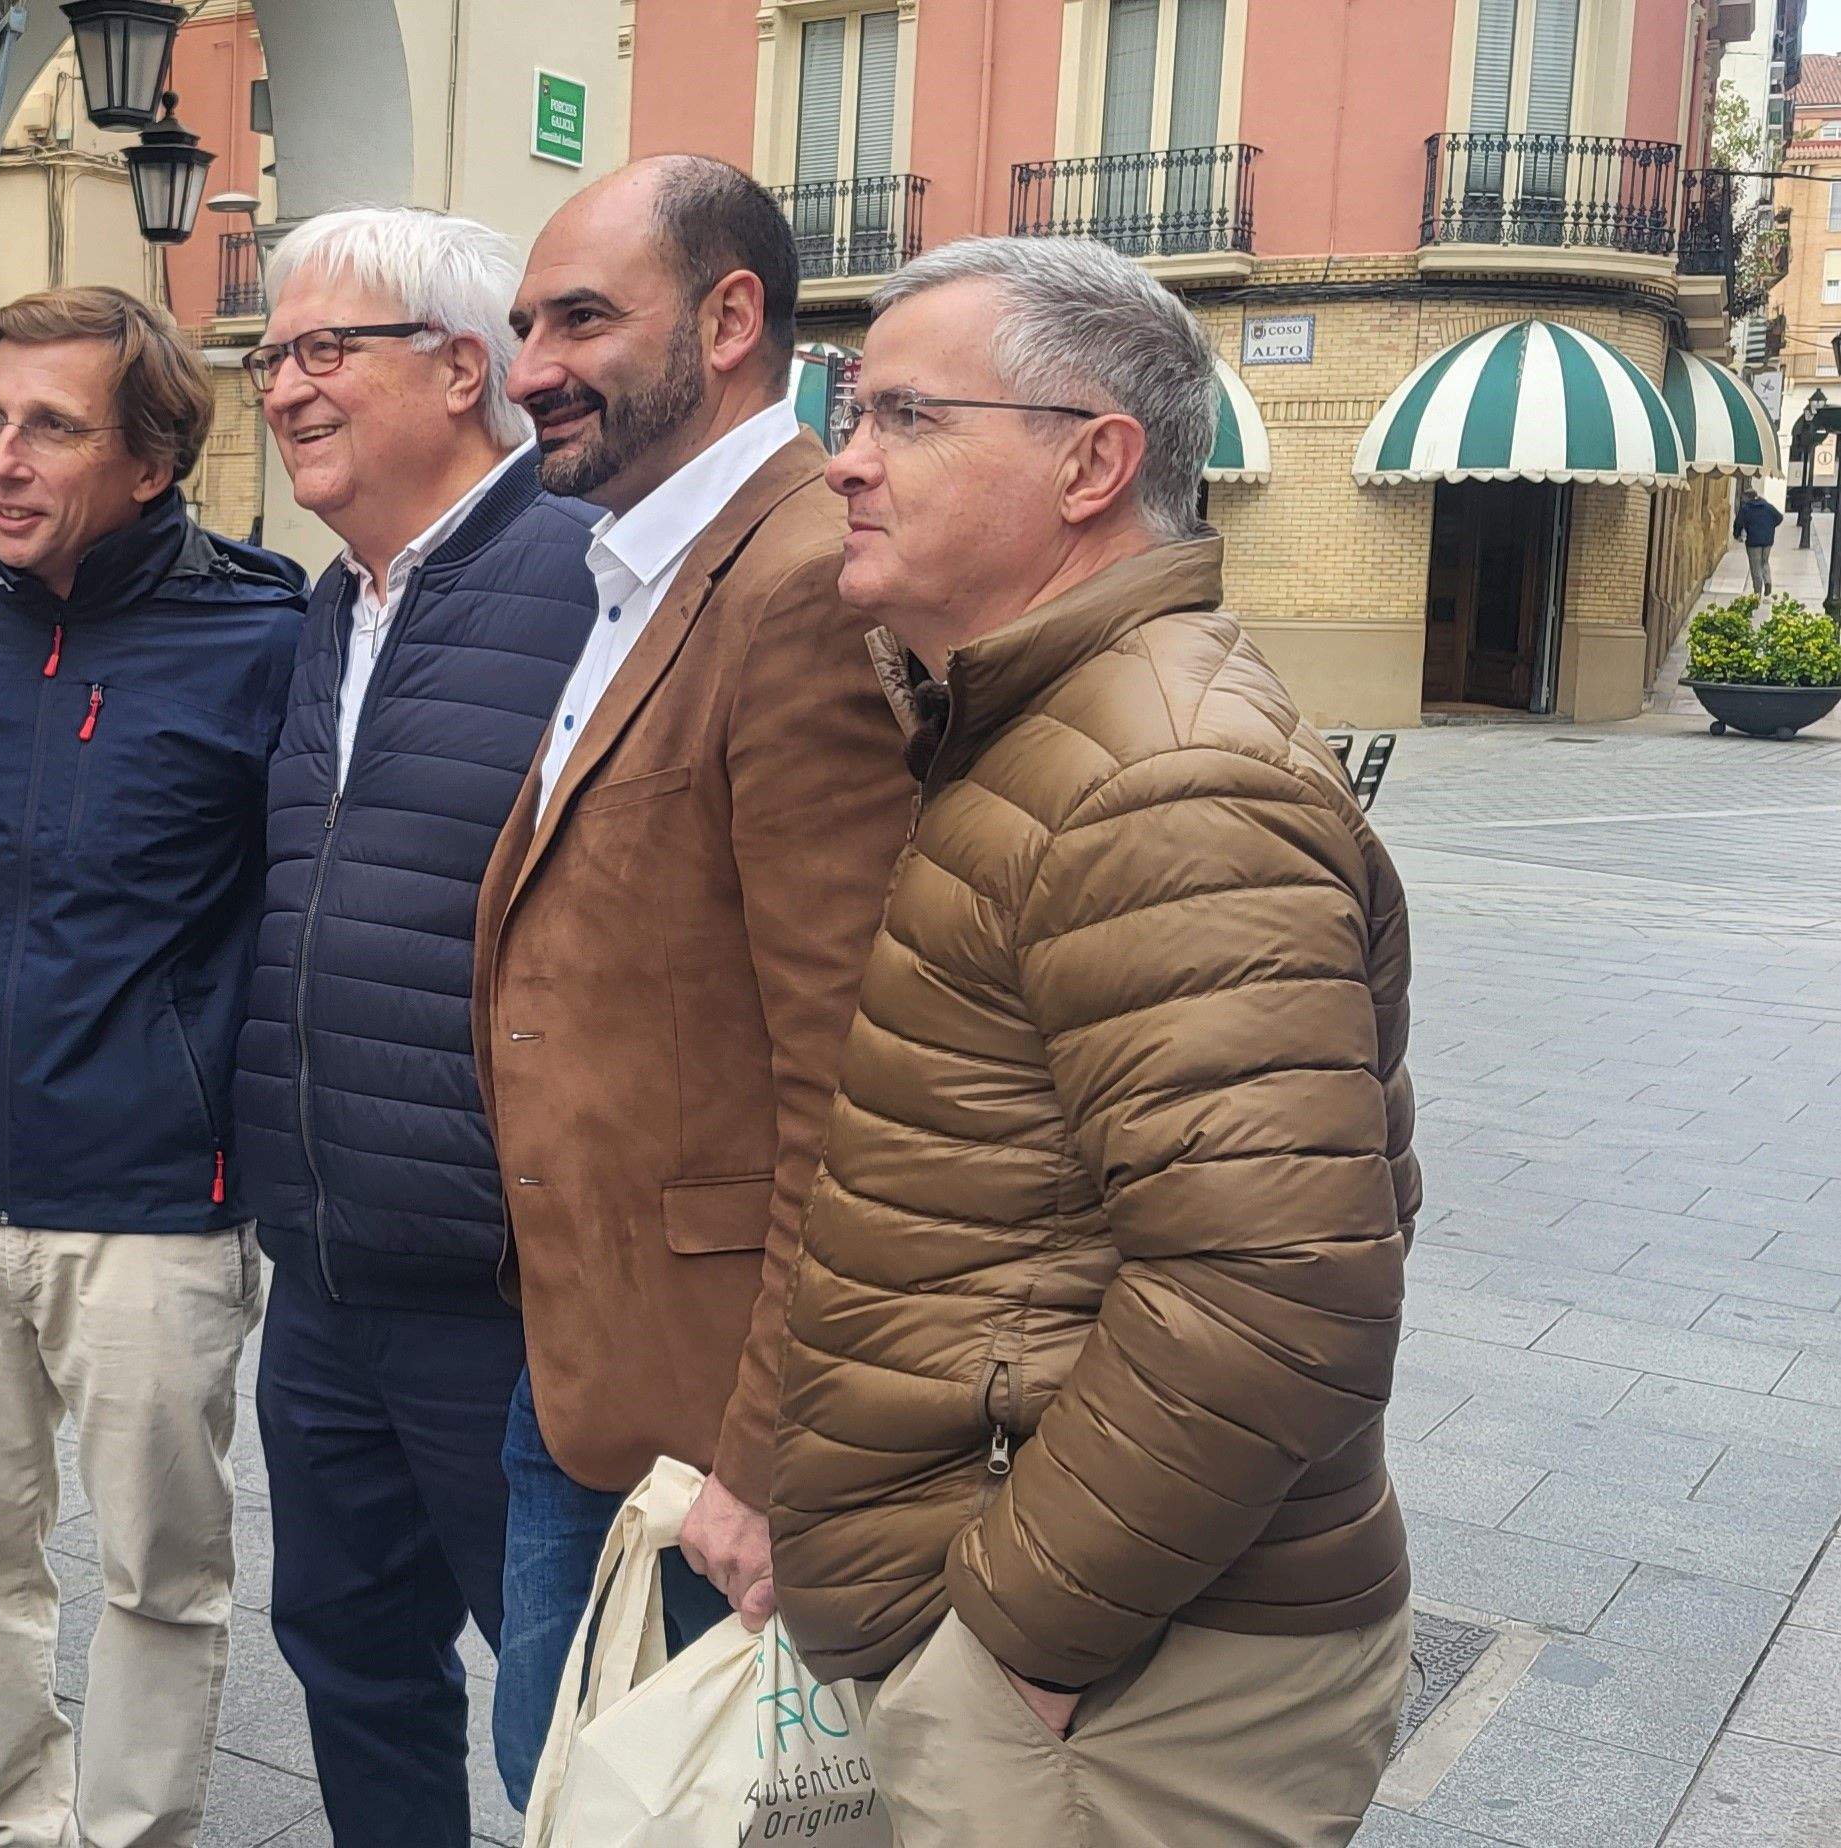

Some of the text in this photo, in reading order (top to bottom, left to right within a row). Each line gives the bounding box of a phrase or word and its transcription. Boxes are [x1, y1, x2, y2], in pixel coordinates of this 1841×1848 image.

[1268, 325, 1302, 336] COSO
[1252, 345, 1303, 358] ALTO
[744, 1755, 871, 1809] Auténtico
[764, 1788, 876, 1840] Original
